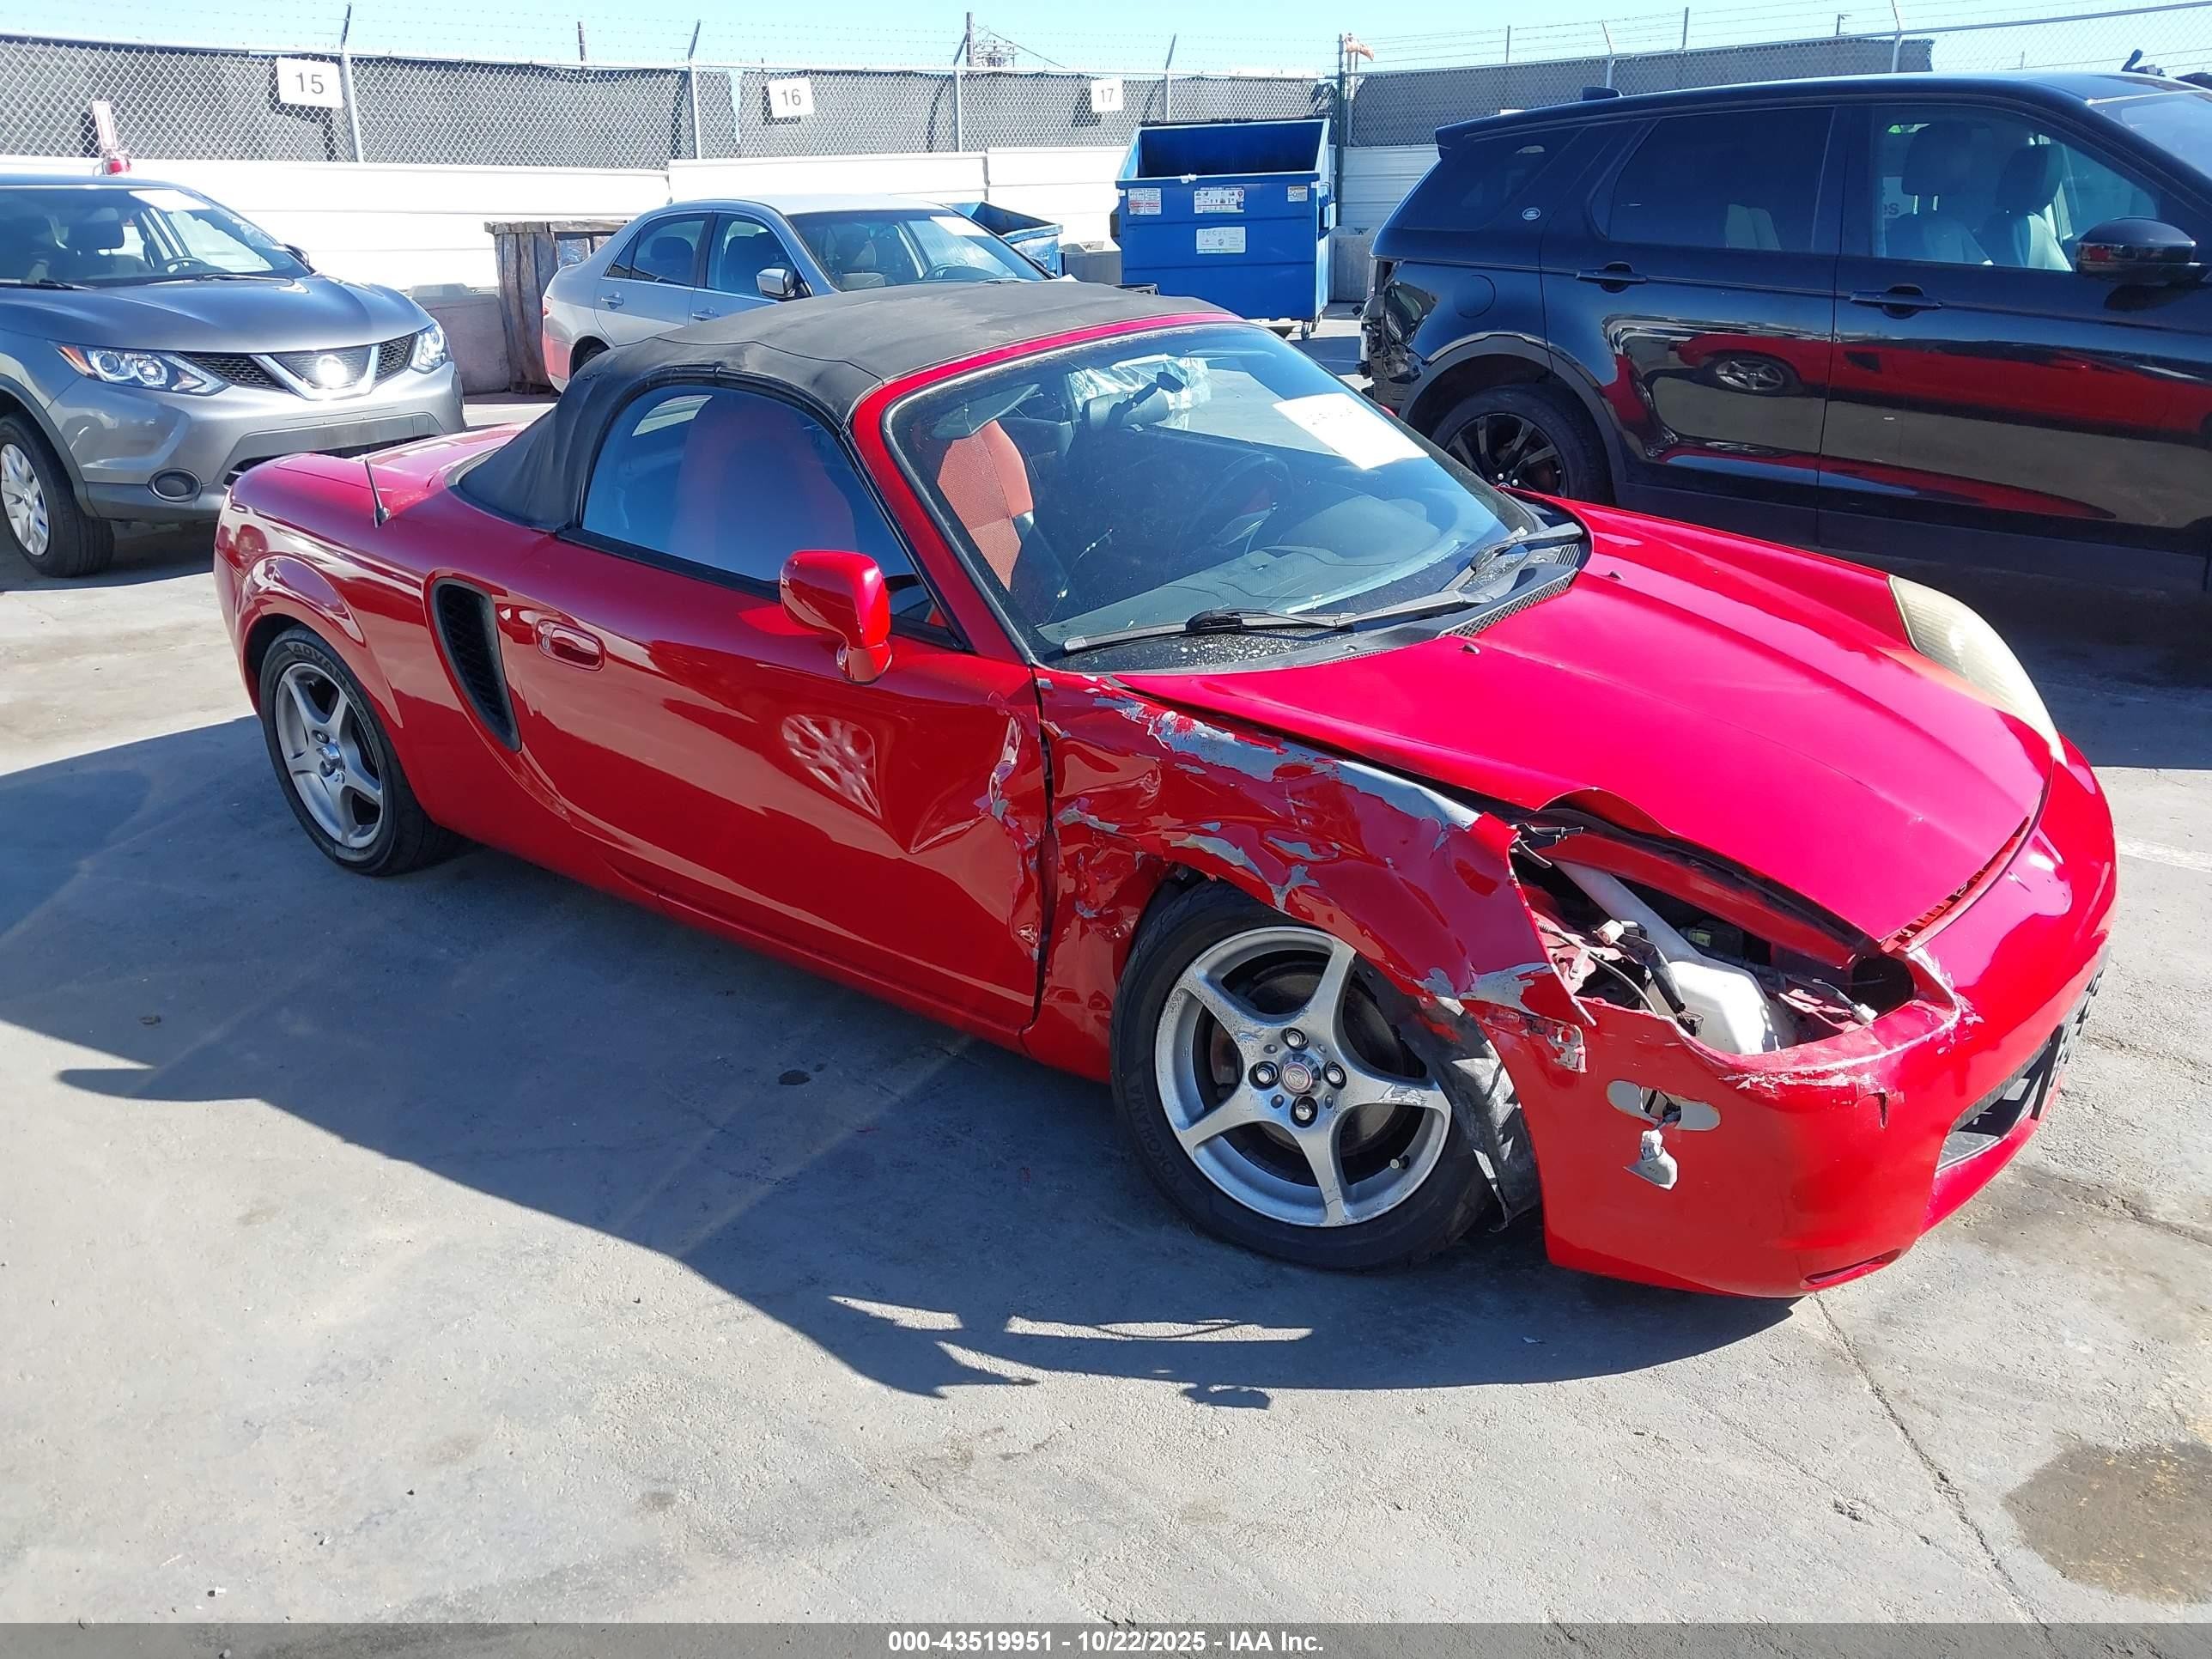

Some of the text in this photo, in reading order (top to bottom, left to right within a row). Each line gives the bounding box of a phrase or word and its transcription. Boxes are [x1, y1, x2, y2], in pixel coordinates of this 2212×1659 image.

[295, 72, 324, 94] 15
[781, 88, 802, 106] 16
[1100, 88, 1114, 104] 17
[293, 643, 348, 687] ADVAN
